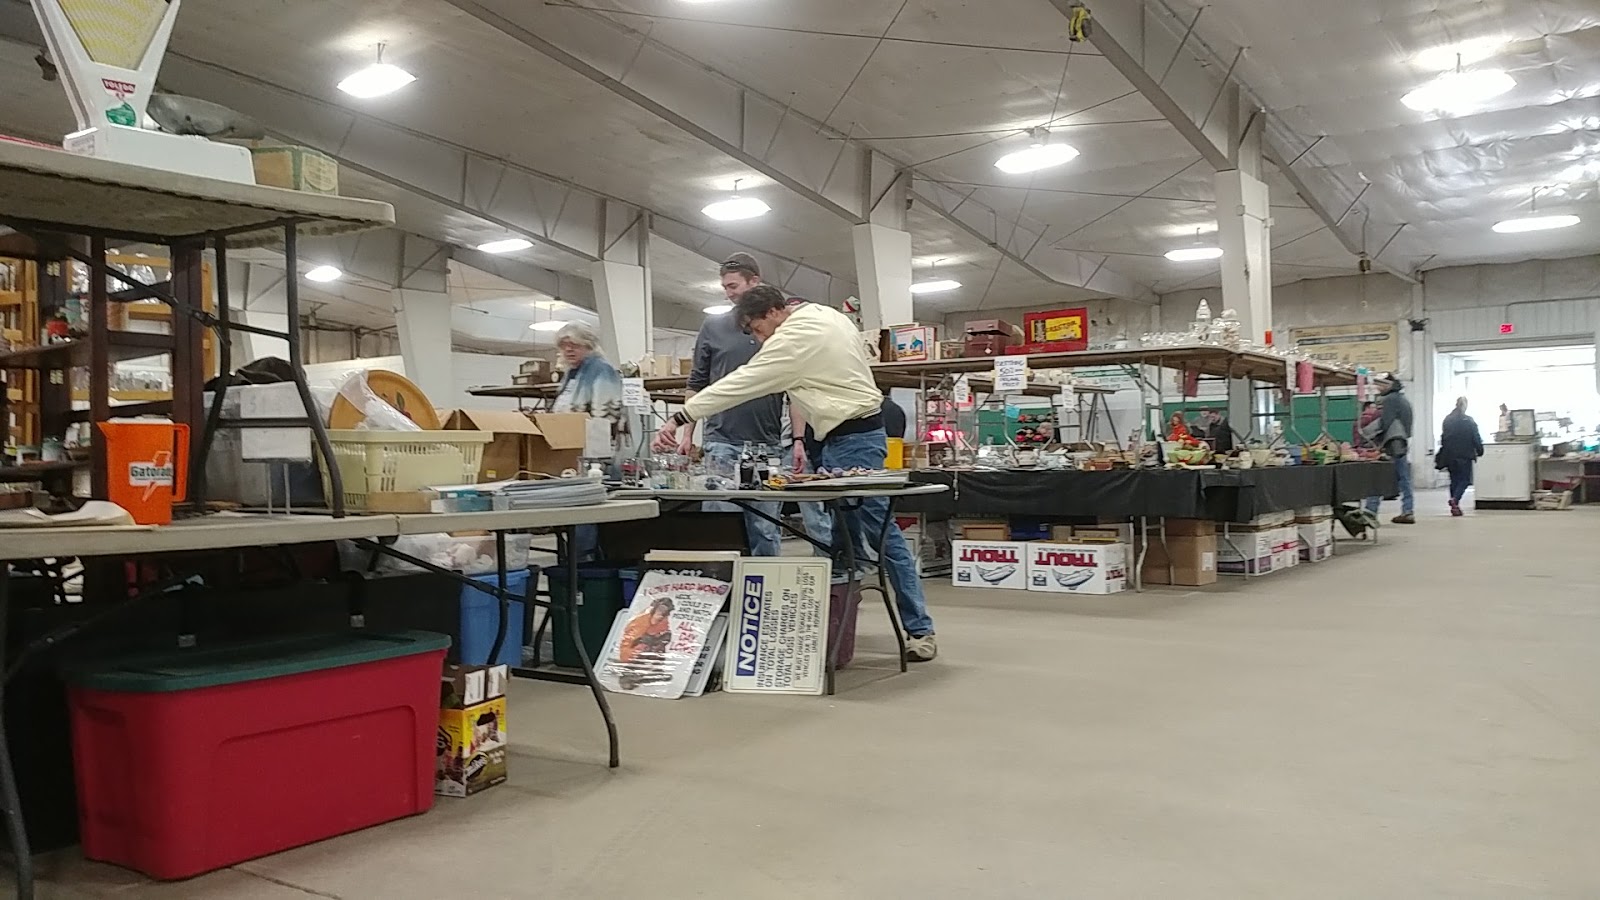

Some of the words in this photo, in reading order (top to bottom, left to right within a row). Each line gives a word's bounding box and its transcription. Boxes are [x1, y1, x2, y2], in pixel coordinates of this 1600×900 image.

[960, 548, 1019, 563] TROUT
[1034, 552, 1098, 567] TROUT
[782, 589, 790, 601] ON
[739, 580, 761, 671] NOTICE
[762, 591, 772, 635] ESTIMATES
[769, 610, 779, 642] LOSSES
[779, 605, 789, 644] CHARGES
[788, 593, 798, 632] VEHICLES
[767, 647, 776, 670] TOTAL
[786, 637, 794, 658] LOSS
[757, 639, 768, 688] INSURANCE
[775, 648, 785, 687] STORAGE
[784, 663, 792, 687] TOTAL
[765, 675, 773, 687] ON
